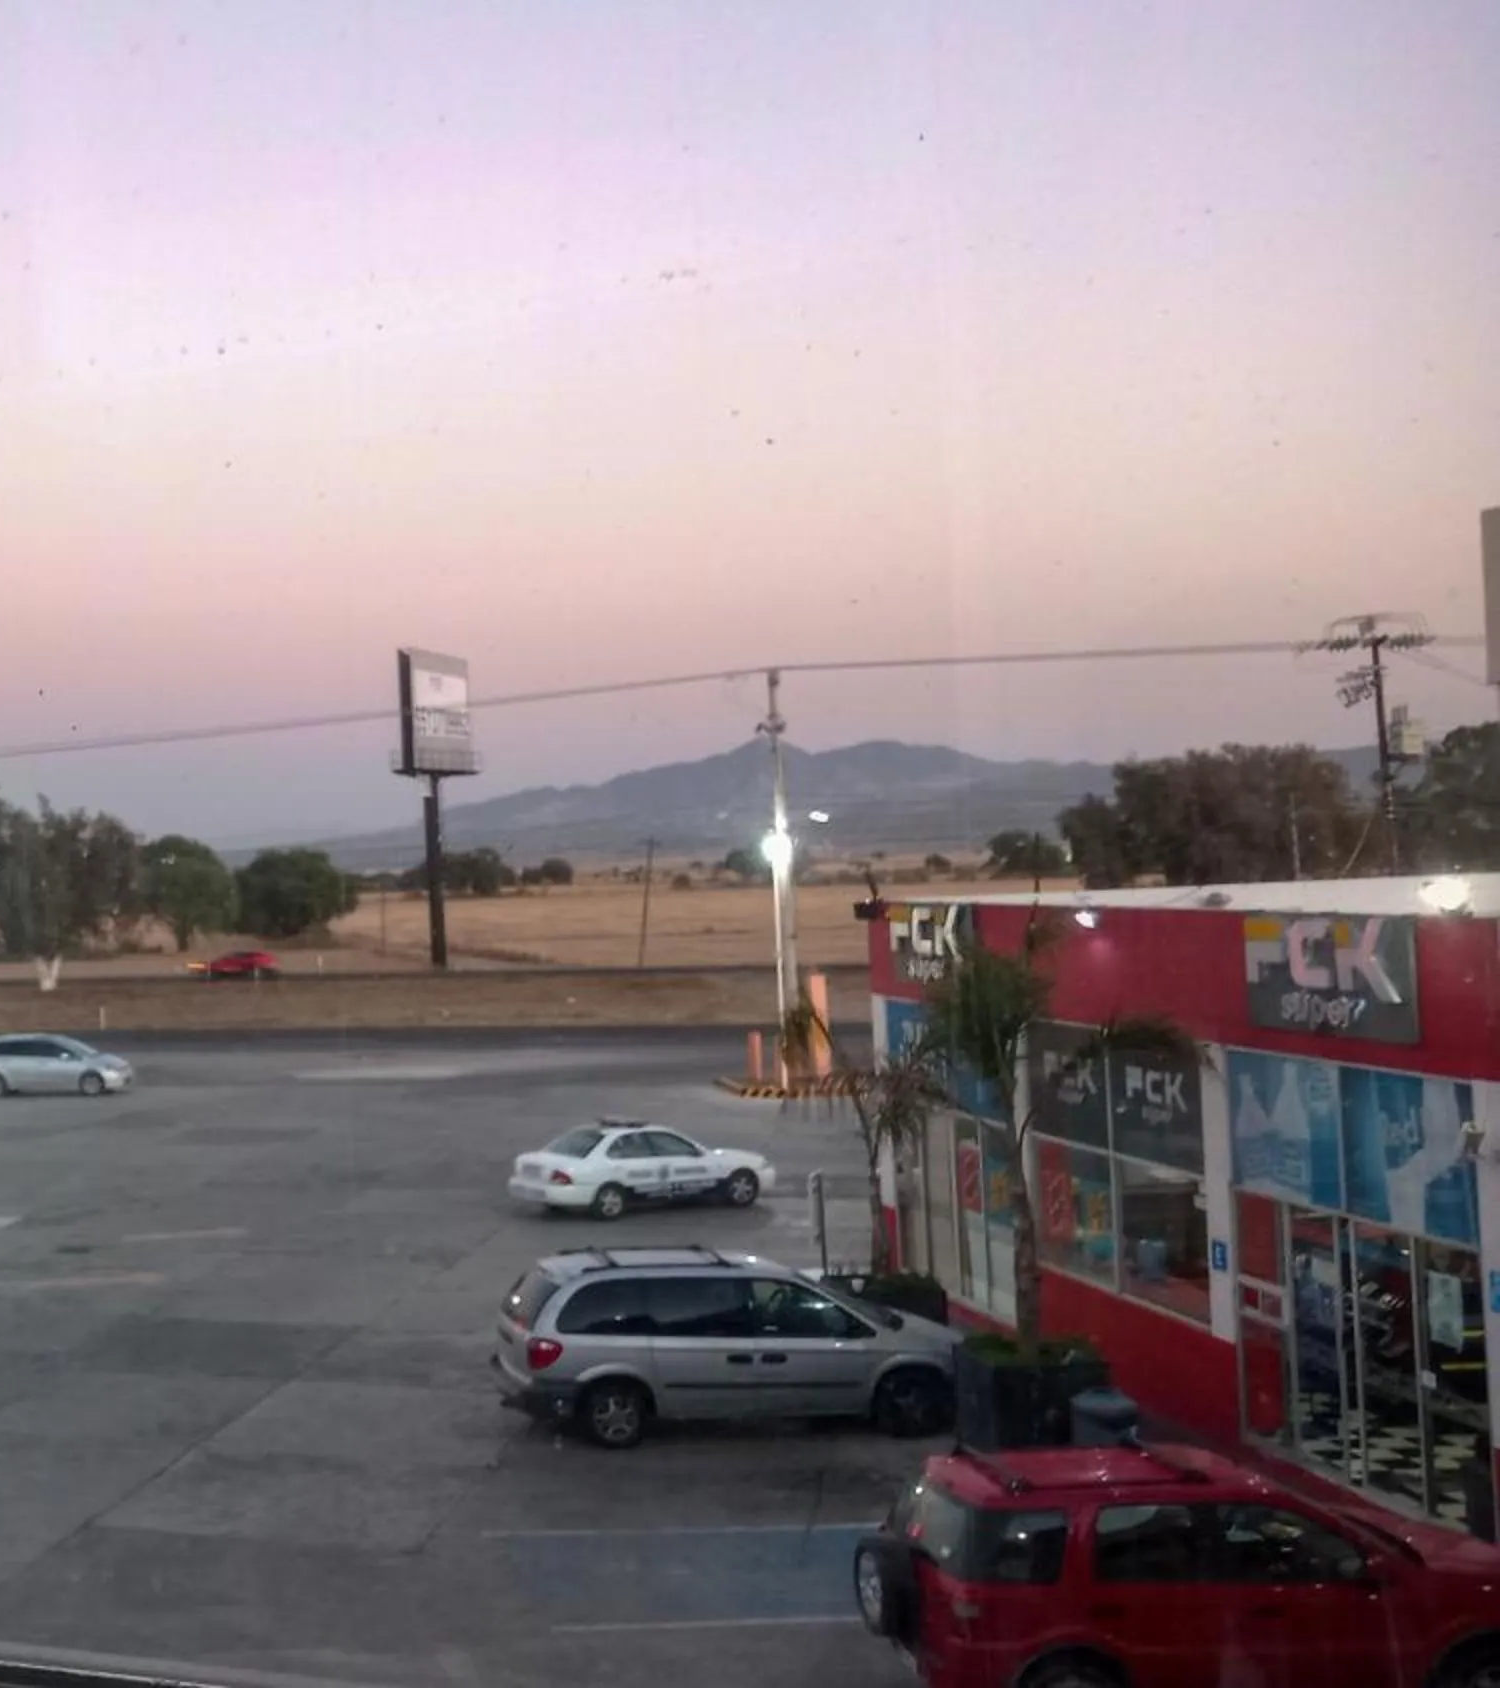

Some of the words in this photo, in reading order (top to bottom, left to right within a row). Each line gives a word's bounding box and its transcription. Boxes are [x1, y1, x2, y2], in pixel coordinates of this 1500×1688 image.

[887, 904, 964, 962] FCK
[1243, 916, 1402, 1004] FCK
[1125, 1065, 1188, 1113] FCK
